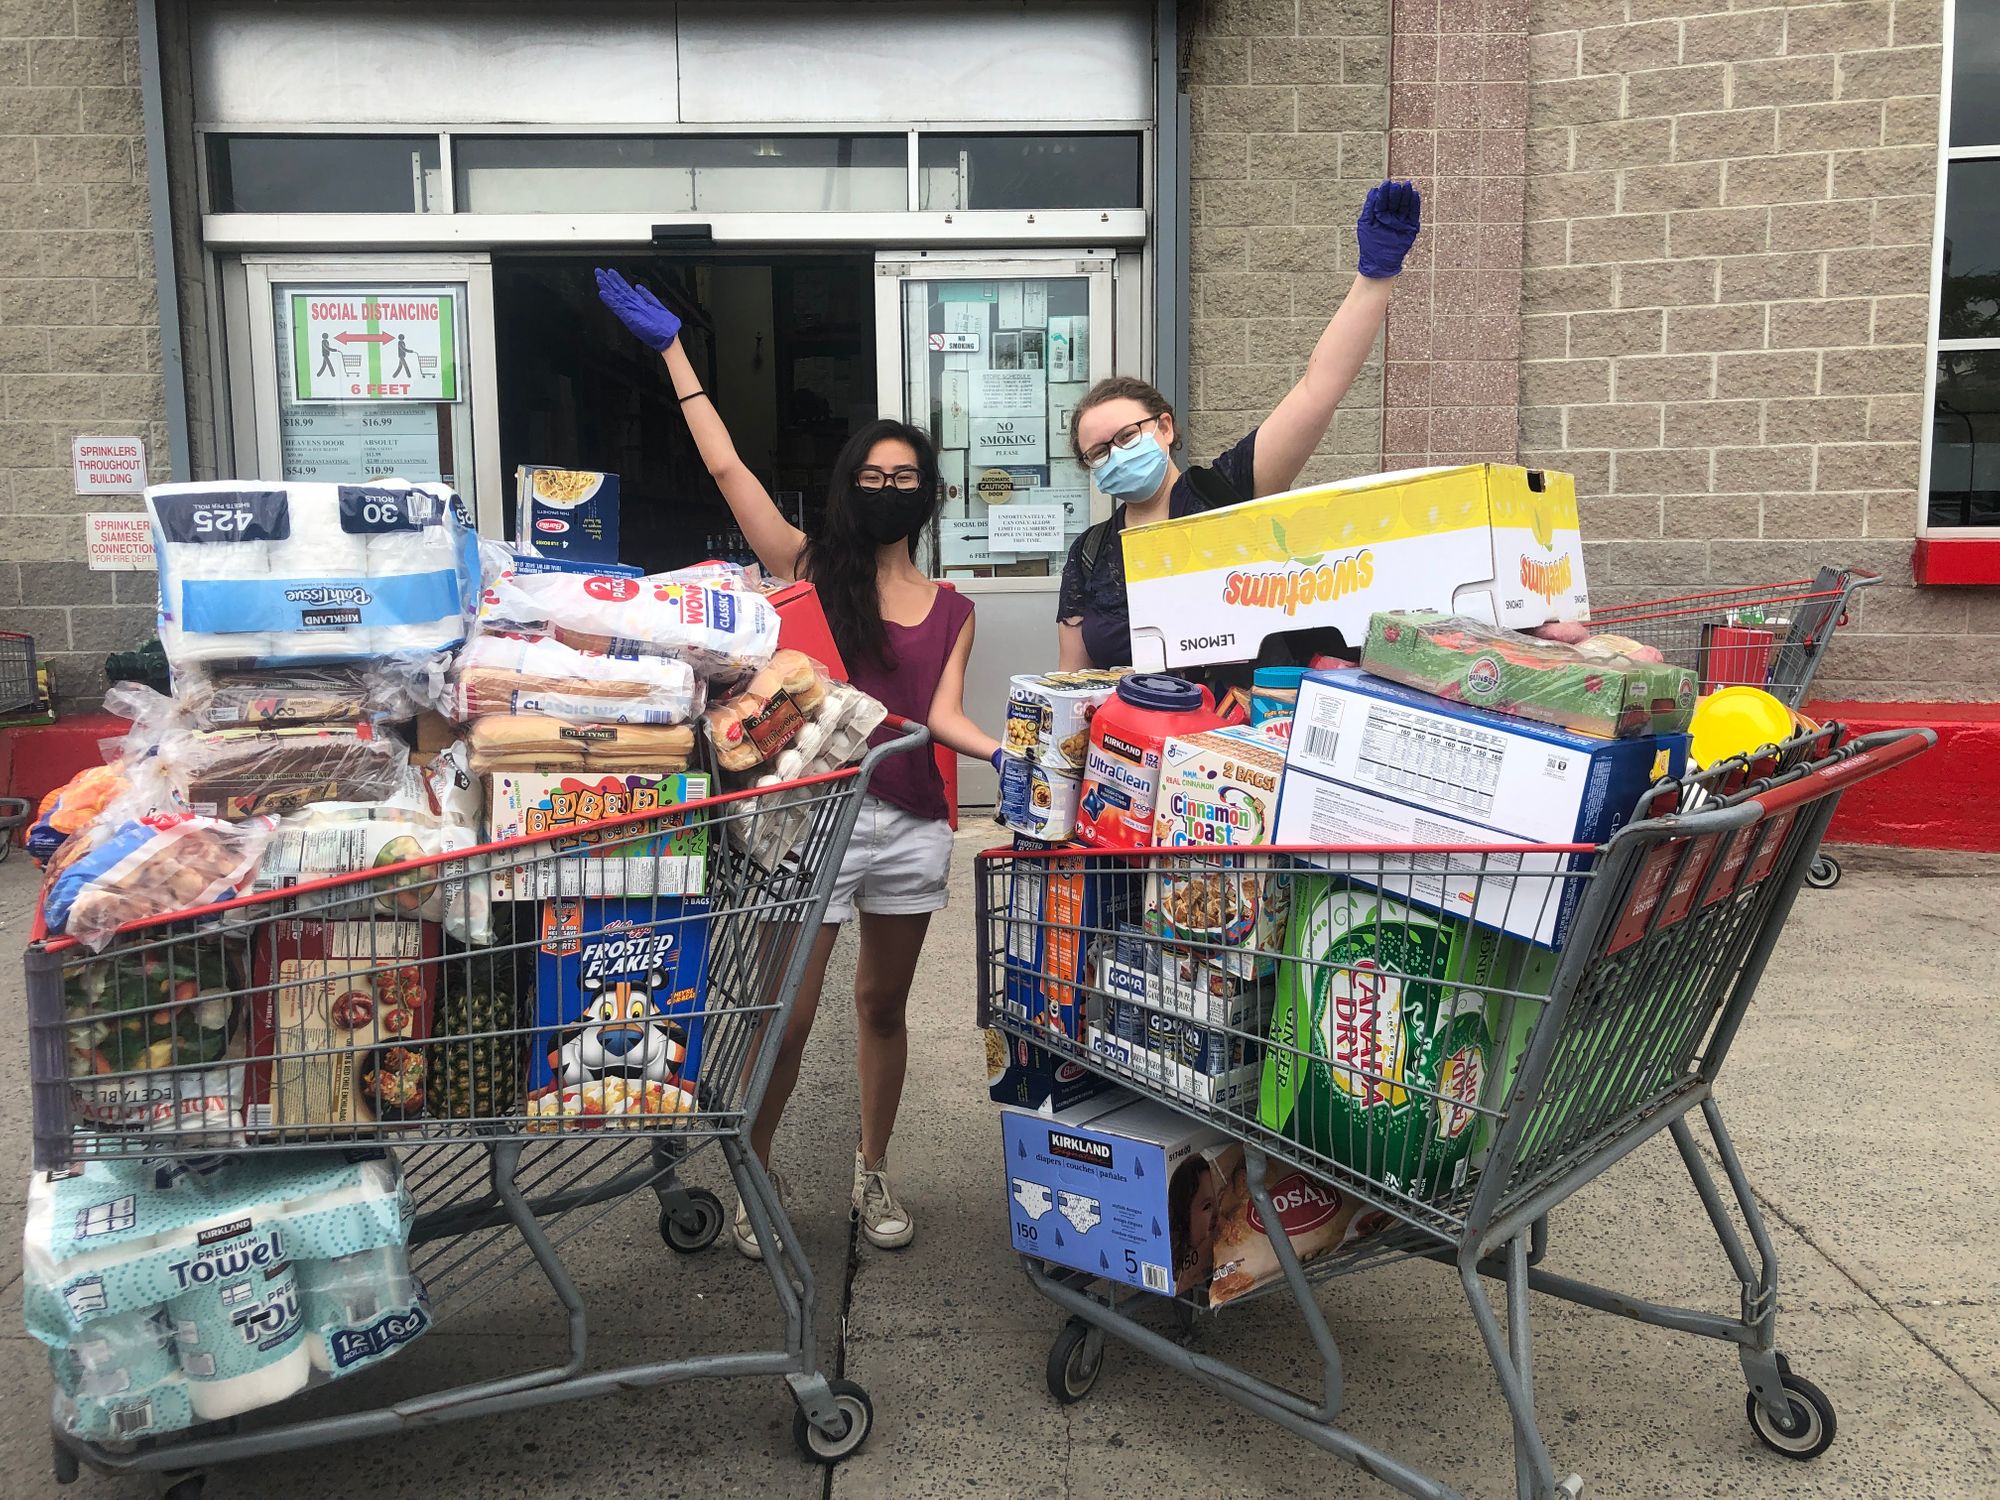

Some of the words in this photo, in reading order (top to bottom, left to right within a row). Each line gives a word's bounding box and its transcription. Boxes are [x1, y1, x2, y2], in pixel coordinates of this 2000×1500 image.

[311, 302, 357, 320] SOCIAL
[361, 303, 439, 321] DISTANCING
[351, 384, 361, 395] 6
[366, 384, 411, 395] FEET
[283, 418, 314, 427] $18.99
[362, 418, 392, 427] $16.99
[997, 422, 1013, 431] NO
[980, 435, 1036, 445] SMOKING
[80, 447, 137, 456] SPRINKLERS
[79, 460, 141, 470] THROUGHOUT
[364, 466, 394, 475] $10.99
[89, 474, 132, 484] BUILDING
[365, 494, 395, 503] ROLLS
[193, 509, 254, 532] 425
[363, 503, 398, 523] 30
[94, 520, 150, 530] SPRINKLER
[539, 521, 562, 530] Barilla
[101, 532, 144, 542] SIAMESE
[562, 540, 569, 548] 4
[91, 544, 157, 554] CONNECTION
[590, 582, 612, 591] 2
[611, 578, 626, 598] PACK
[1223, 549, 1375, 616] sweetums
[1519, 553, 1572, 608] sweetums
[718, 596, 730, 629] CLASSIC
[1504, 598, 1525, 611] LEMONS
[304, 613, 359, 625] KIRKLAND
[1180, 632, 1237, 652] LEMONS
[1468, 673, 1499, 688] SUNSET
[751, 712, 766, 727] OLD
[565, 729, 585, 738] OLD
[587, 731, 611, 739] TYME
[1400, 728, 1411, 737] 160
[1415, 732, 1426, 741] 160
[1430, 736, 1441, 744] 150
[1445, 740, 1456, 748] 160
[1460, 744, 1471, 753] 150
[1475, 748, 1486, 757] 150
[1104, 734, 1141, 757] KIRKLAND
[1145, 752, 1159, 764] 152
[1089, 753, 1151, 793] UltraClean
[1223, 761, 1234, 779] 2
[1235, 765, 1277, 793] BAGS!
[1165, 775, 1181, 786] REAL
[1182, 779, 1215, 791] CINNAMON
[1173, 794, 1250, 829] Cinnamon
[1185, 815, 1234, 846] Toast
[1016, 839, 1044, 850] FROSTED
[690, 897, 710, 905] BAGS
[582, 934, 674, 962] FROSTED
[1475, 929, 1492, 986] GINGE
[585, 952, 665, 978] FLAKES
[1110, 971, 1143, 990] GOYA
[1335, 995, 1359, 1072] DRY
[1352, 959, 1387, 1110] CANADA
[1386, 1010, 1395, 1040] SINCE
[1265, 1015, 1280, 1065] ALE
[1278, 1005, 1295, 1088] GINGER
[1095, 1041, 1126, 1062] GOYA
[1387, 1045, 1395, 1069] 1904
[343, 1065, 351, 1076] RED
[342, 1076, 351, 1091] CHILE
[1450, 1045, 1468, 1137] CANADA
[1465, 1061, 1478, 1105] DRY
[339, 1091, 349, 1122] ENCHILADAS
[1052, 1134, 1110, 1158] KIRKLAND
[1035, 1154, 1062, 1167] diapers
[1065, 1163, 1095, 1175] couches
[1100, 1169, 1128, 1183] pañales
[200, 1220, 250, 1240] KIRKLAND
[1016, 1222, 1038, 1241] 150
[197, 1236, 258, 1260] PREMIUM
[1124, 1249, 1138, 1274] 5
[339, 1334, 368, 1352] 12
[377, 1313, 420, 1340] 160
[343, 1345, 370, 1361] ROLLS
